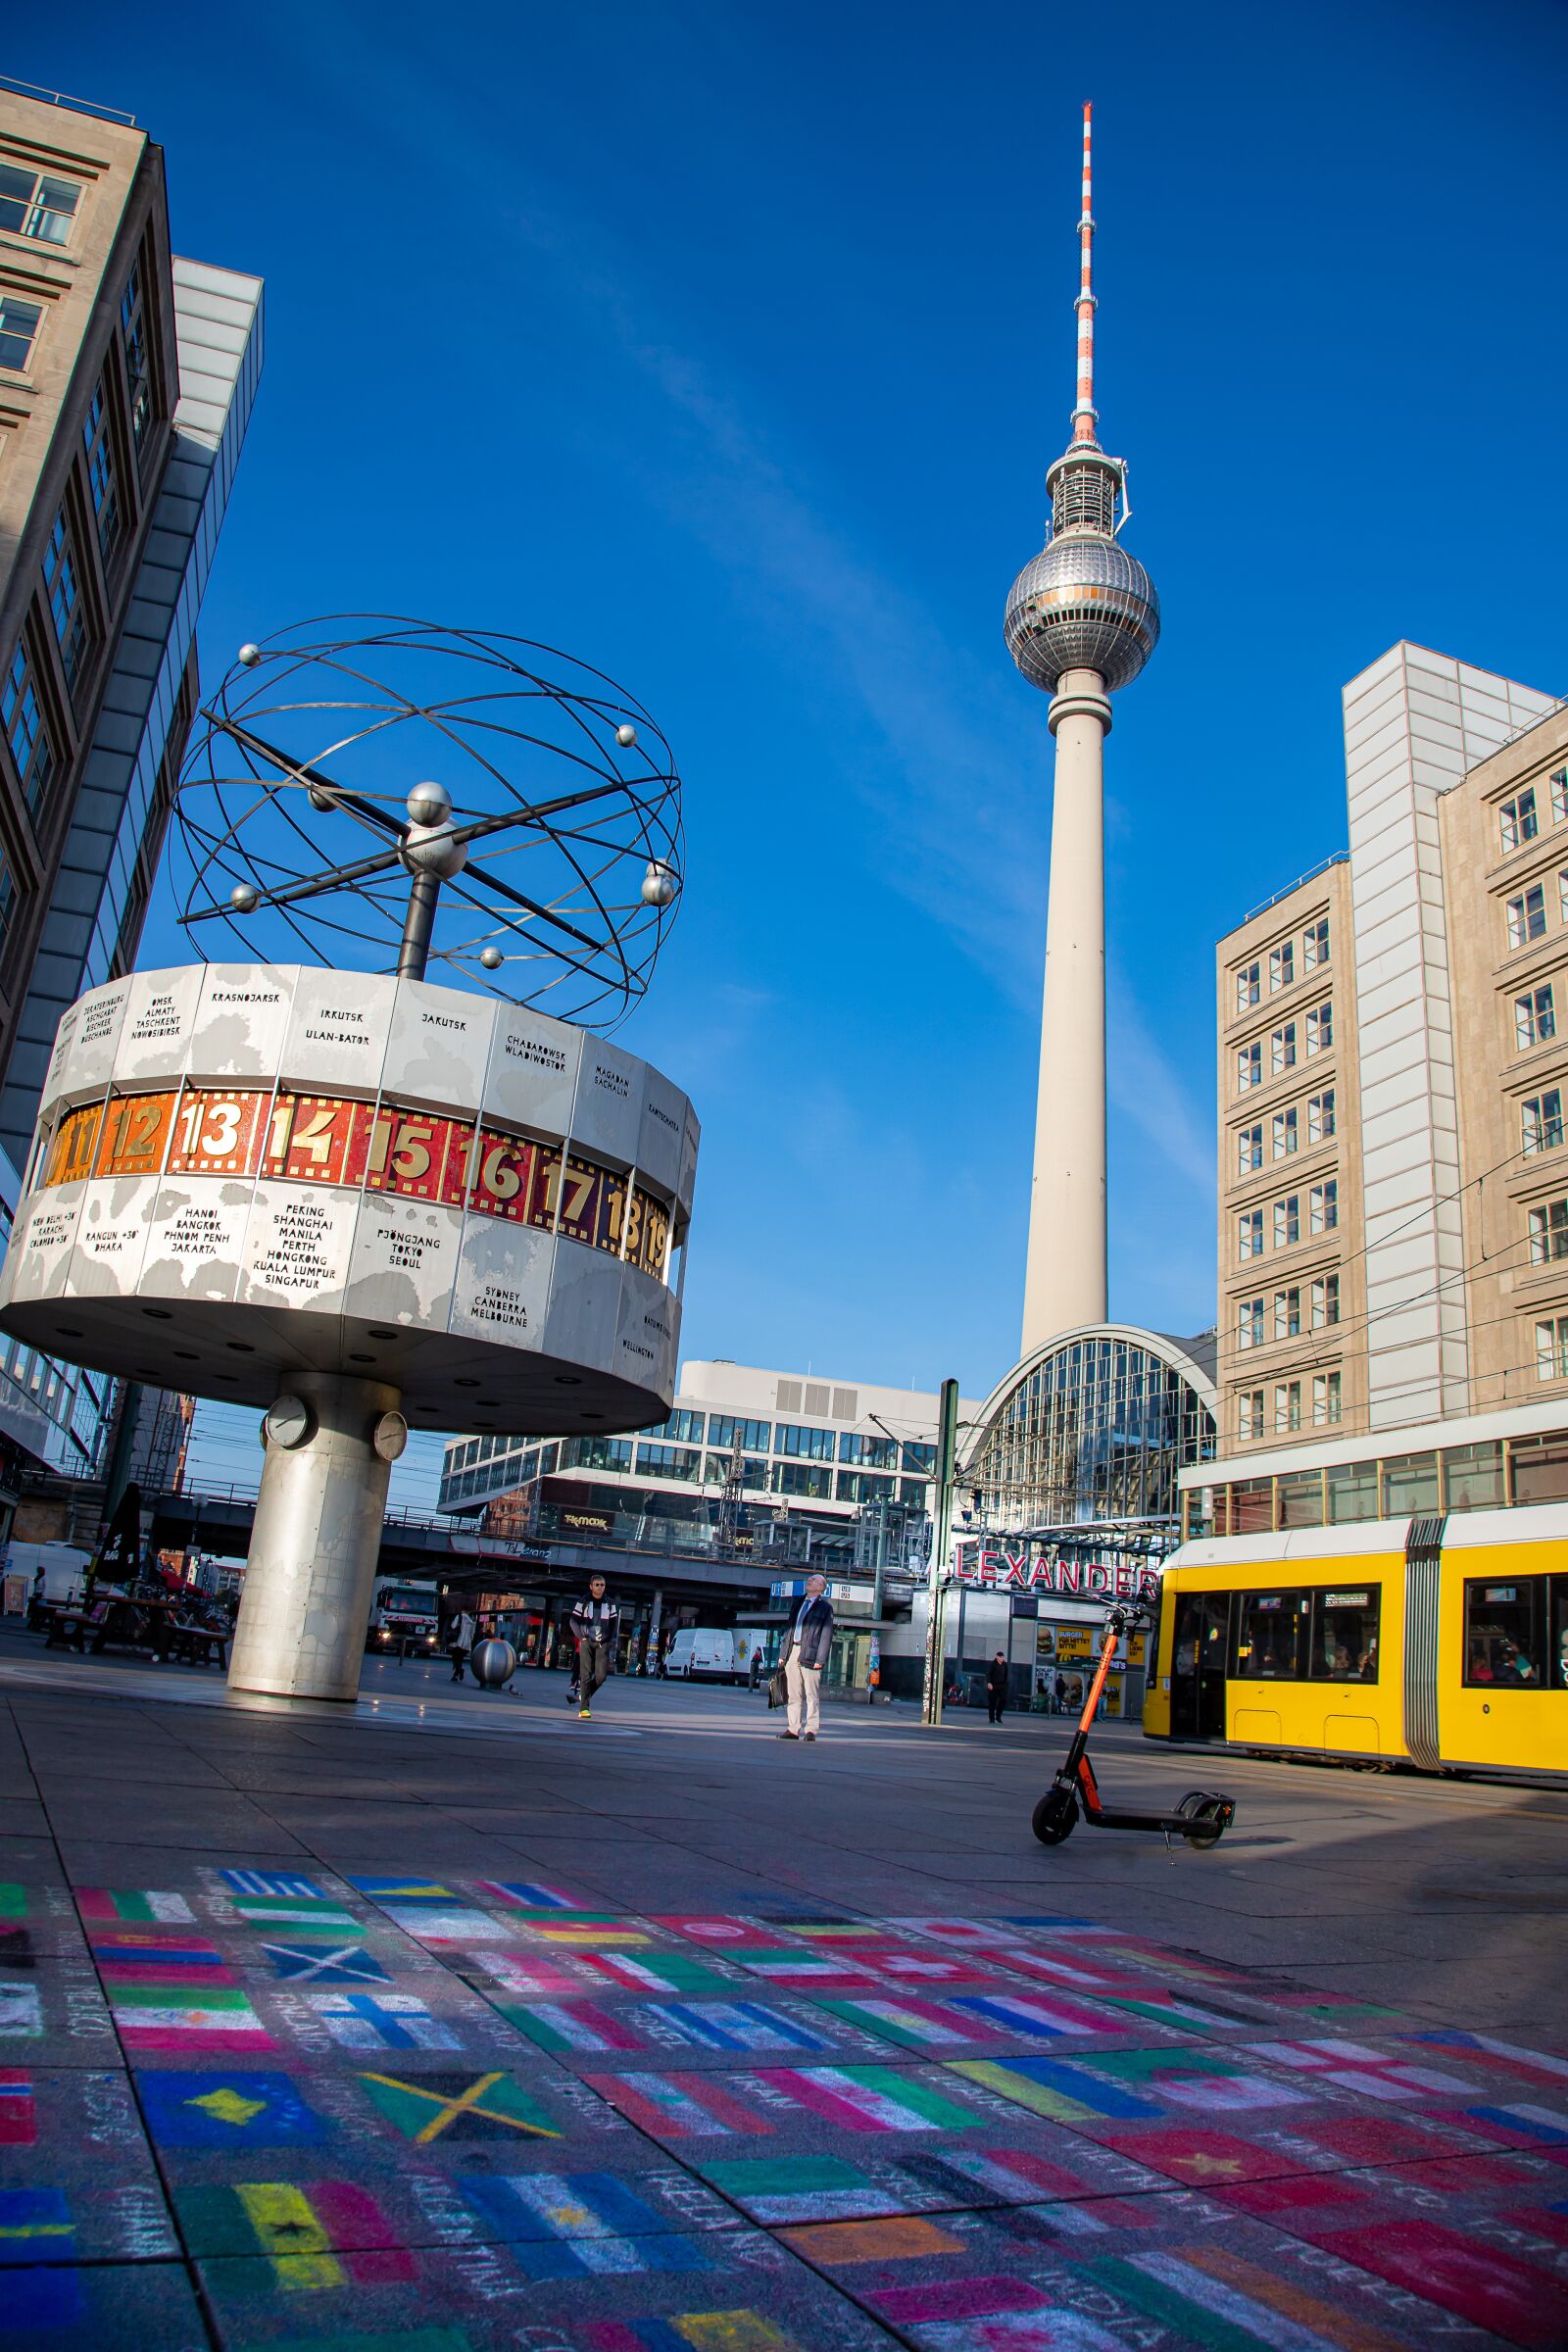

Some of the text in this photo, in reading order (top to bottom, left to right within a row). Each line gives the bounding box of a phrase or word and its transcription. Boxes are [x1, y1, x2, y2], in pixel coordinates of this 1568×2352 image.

[151, 996, 173, 1007] OMSK
[212, 993, 280, 1003] KRASNOJARSK
[145, 1005, 176, 1018] ALMATY
[320, 1009, 364, 1022] IRKUTSK
[136, 1016, 180, 1029] TASCHKENT
[421, 1013, 466, 1031] JAKUTSK
[130, 1026, 180, 1040] NOWOSIBIRSK
[306, 1029, 369, 1045] ULAN-BATOR
[507, 1035, 566, 1061] CHABAROWSK
[505, 1044, 565, 1072] WLADIWOSTOK
[595, 1065, 630, 1088] MAGADAN
[594, 1076, 628, 1098] SACHALIN
[112, 1105, 162, 1158] 12
[181, 1102, 242, 1155] 13
[270, 1107, 336, 1164] 14
[365, 1120, 433, 1179] 15
[459, 1138, 523, 1199] 16
[542, 1160, 595, 1222] 17
[185, 1208, 218, 1218] HANOI
[286, 1204, 325, 1217] PEKING
[175, 1220, 221, 1231] BANGKOK
[273, 1214, 333, 1231] SHANGHAI
[608, 1190, 642, 1250] 18
[85, 1231, 118, 1241] RANGUN
[164, 1231, 230, 1244] PHNOM PENH
[278, 1227, 322, 1241] MANILA
[376, 1229, 441, 1250] PJÖNGJANG
[647, 1212, 668, 1268] 19
[94, 1243, 122, 1252] DHAKA
[171, 1243, 217, 1254] JAKARTA
[282, 1240, 316, 1252] PERTH
[392, 1244, 423, 1257] TOKYO
[267, 1250, 327, 1266] HONGKONG
[388, 1255, 421, 1269] SEOUL
[253, 1260, 336, 1280] KUALA LUMPUR
[265, 1274, 319, 1290] SINGAPUR
[485, 1286, 520, 1301] SYDNEY
[474, 1296, 527, 1316] CANBERRA
[470, 1307, 528, 1328] MELBOURNE
[622, 1338, 654, 1361] WELLINGTON
[268, 1992, 330, 2054] FINLAND
[612, 2005, 692, 2051] ISRAEL
[726, 2075, 808, 2109] IRAN
[637, 2167, 788, 2269] IRELAND
